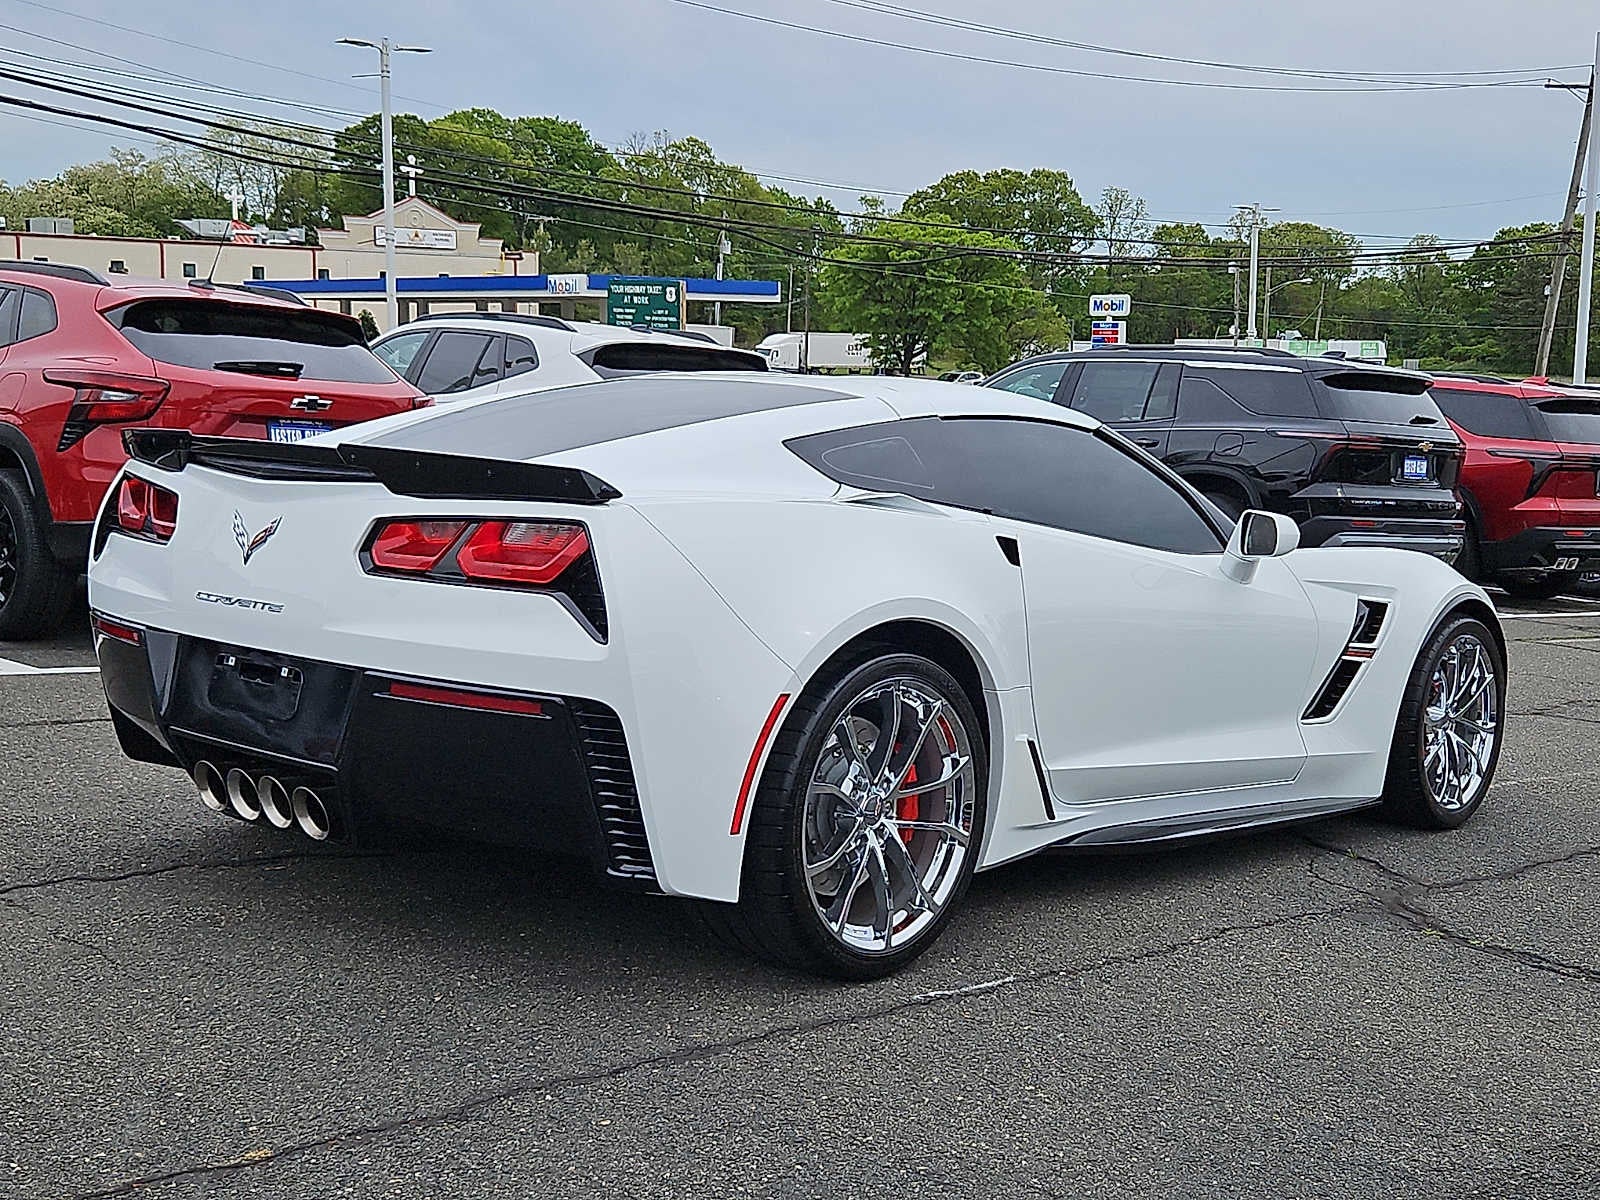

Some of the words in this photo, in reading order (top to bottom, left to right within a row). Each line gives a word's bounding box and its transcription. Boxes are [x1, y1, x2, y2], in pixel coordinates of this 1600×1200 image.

[549, 279, 577, 292] Mobil
[623, 296, 631, 304] AT
[633, 296, 649, 304] WORK
[1093, 299, 1125, 311] Mobil
[196, 592, 285, 613] CORVETTE
